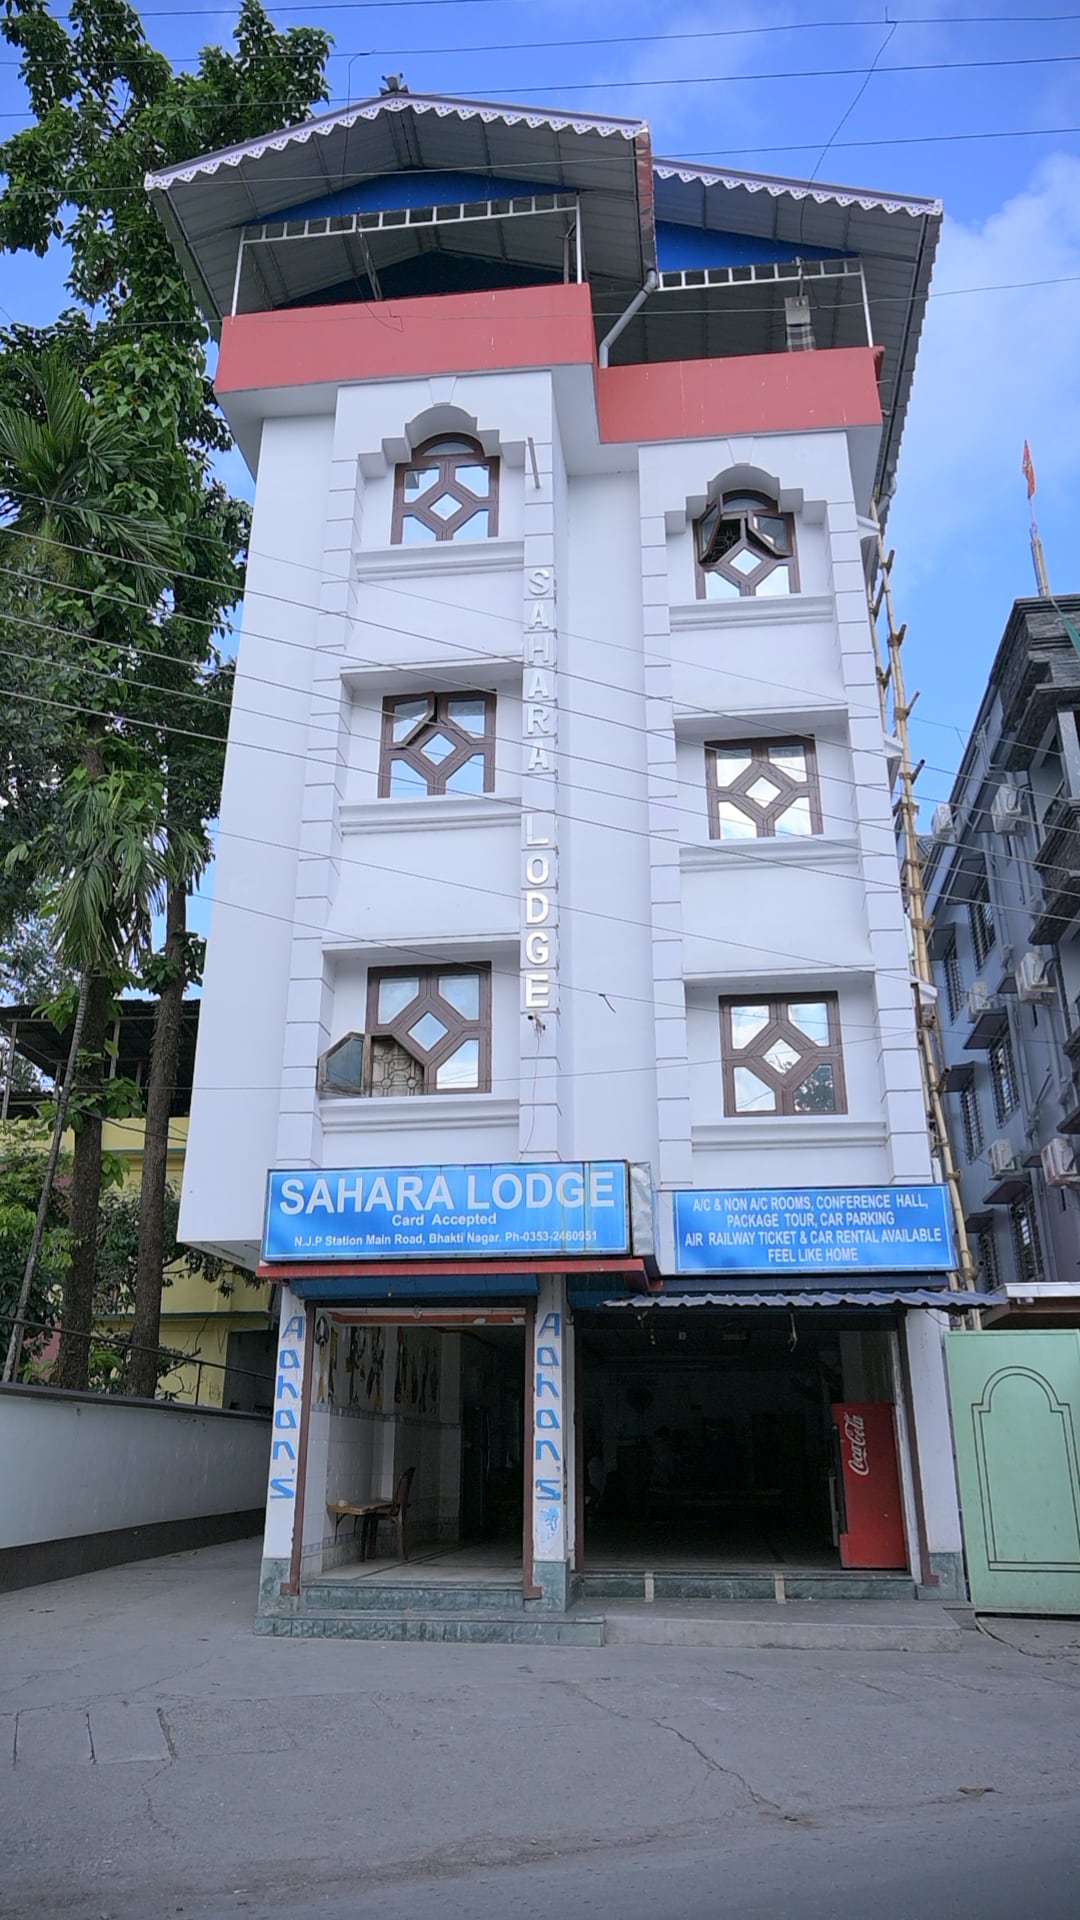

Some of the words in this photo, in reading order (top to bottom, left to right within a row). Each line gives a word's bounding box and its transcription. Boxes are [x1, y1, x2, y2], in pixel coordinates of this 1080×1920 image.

[528, 568, 550, 771] SAHARA
[525, 814, 549, 1008] LODGE
[280, 1174, 454, 1215] SAHARA
[469, 1171, 615, 1211] LODGE
[693, 1198, 711, 1212] A/C
[713, 1198, 721, 1211] &
[724, 1197, 747, 1211] NON
[750, 1197, 768, 1211] A/C
[771, 1196, 814, 1212] ROOMS,
[816, 1194, 891, 1209] CONFERENCE
[896, 1193, 928, 1209] HALL,
[392, 1214, 424, 1226] Card
[432, 1212, 496, 1228] Accepted
[727, 1213, 779, 1227] PACKAGE
[784, 1212, 818, 1229] TOUR,
[820, 1212, 844, 1226] CAR
[845, 1211, 895, 1226] PARKING
[325, 1235, 362, 1247] Station
[366, 1234, 391, 1245] Main
[394, 1233, 425, 1246] Road,
[429, 1232, 464, 1244] Bhakti
[685, 1232, 703, 1246] AIR
[708, 1231, 755, 1246] RAILWAY
[758, 1231, 796, 1245] TICKET
[799, 1231, 808, 1244] &
[810, 1230, 834, 1244] CAR
[836, 1229, 879, 1244] RENTAL
[881, 1228, 942, 1242] AVAILABLE
[768, 1248, 796, 1263] FEEL
[798, 1248, 823, 1262] LIKE
[825, 1247, 858, 1262] HOME
